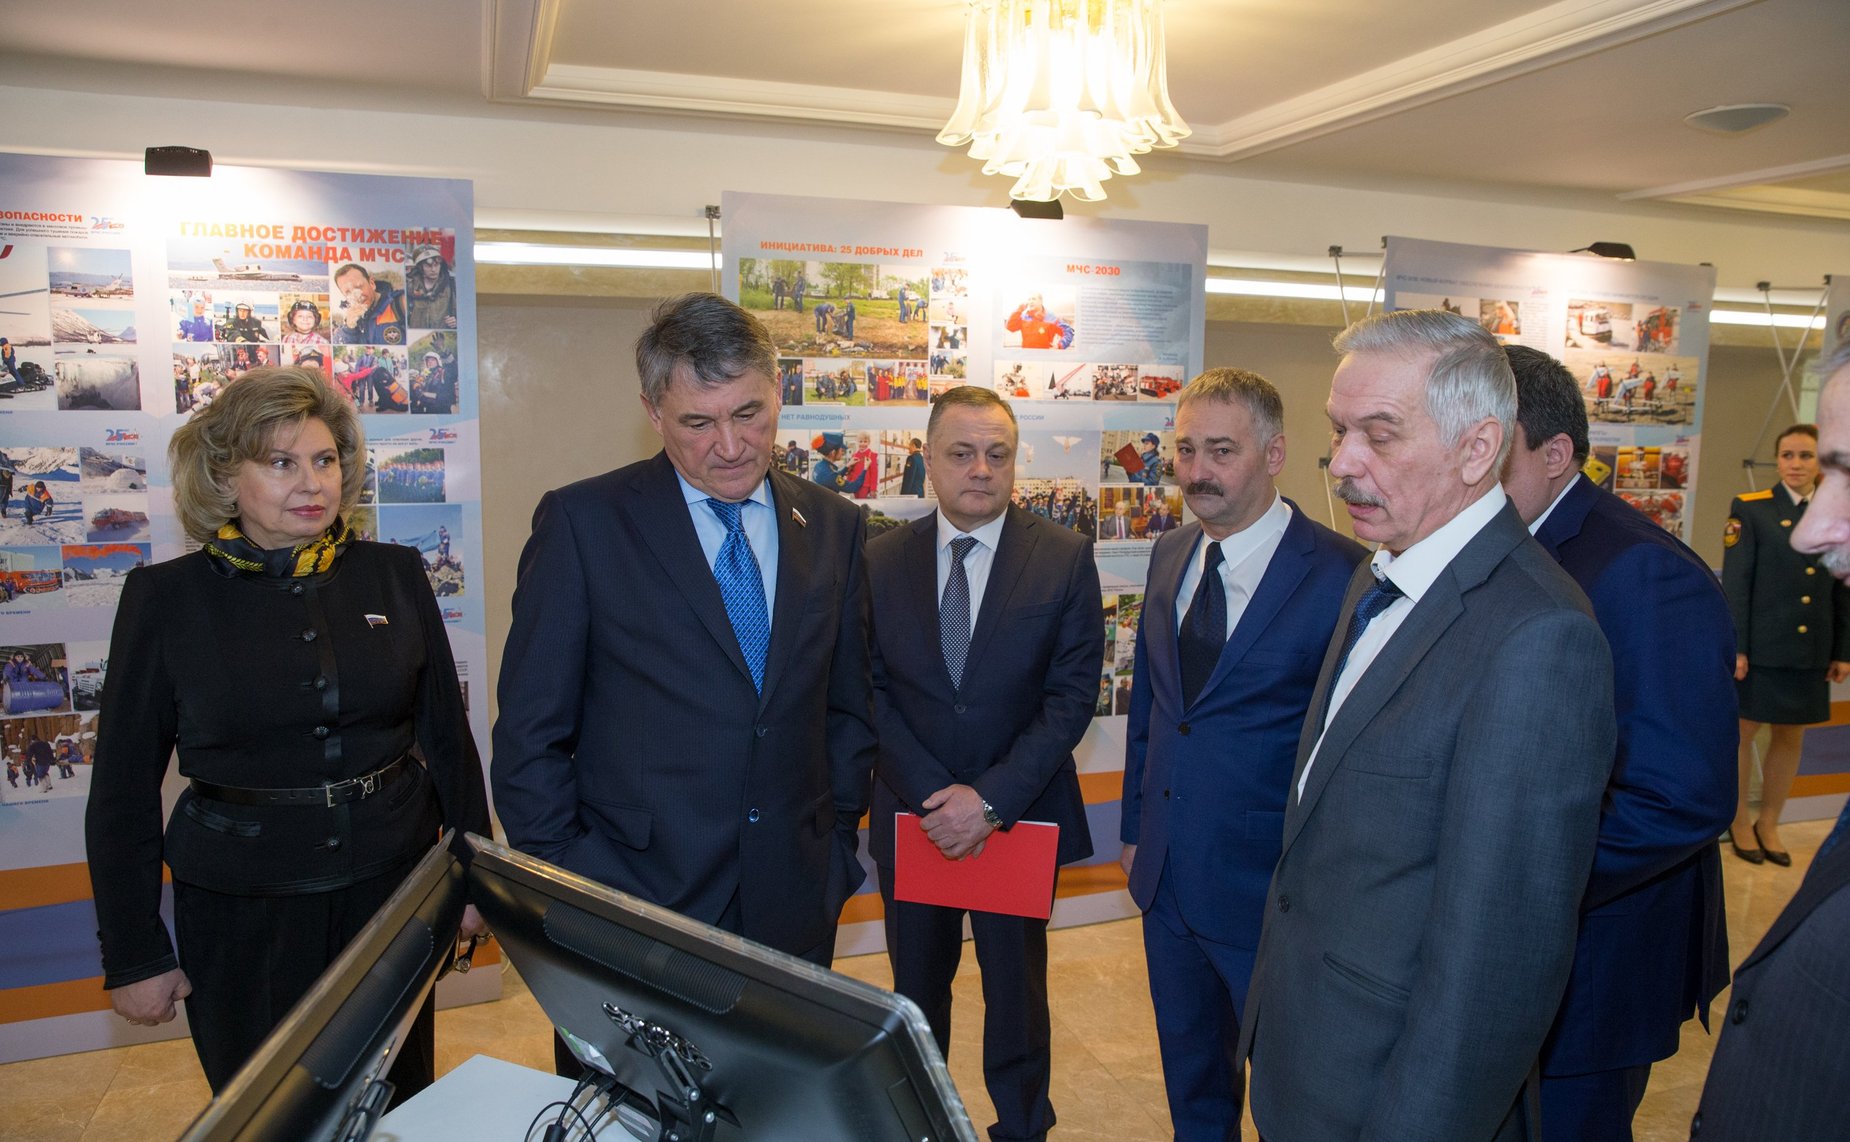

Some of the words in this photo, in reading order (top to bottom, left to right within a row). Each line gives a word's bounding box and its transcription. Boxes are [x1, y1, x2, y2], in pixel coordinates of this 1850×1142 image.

[180, 221, 285, 239] ГЛАВНОЕ
[292, 226, 444, 246] ДОСТИЖЕНИЕ
[243, 243, 353, 264] КОМАНДА
[359, 247, 406, 264] МЧС
[760, 240, 837, 254] ИНИЦИАТИВА:
[840, 245, 852, 254] 25
[854, 246, 899, 257] ДОБРЫХ
[902, 249, 923, 258] ДЕЛ
